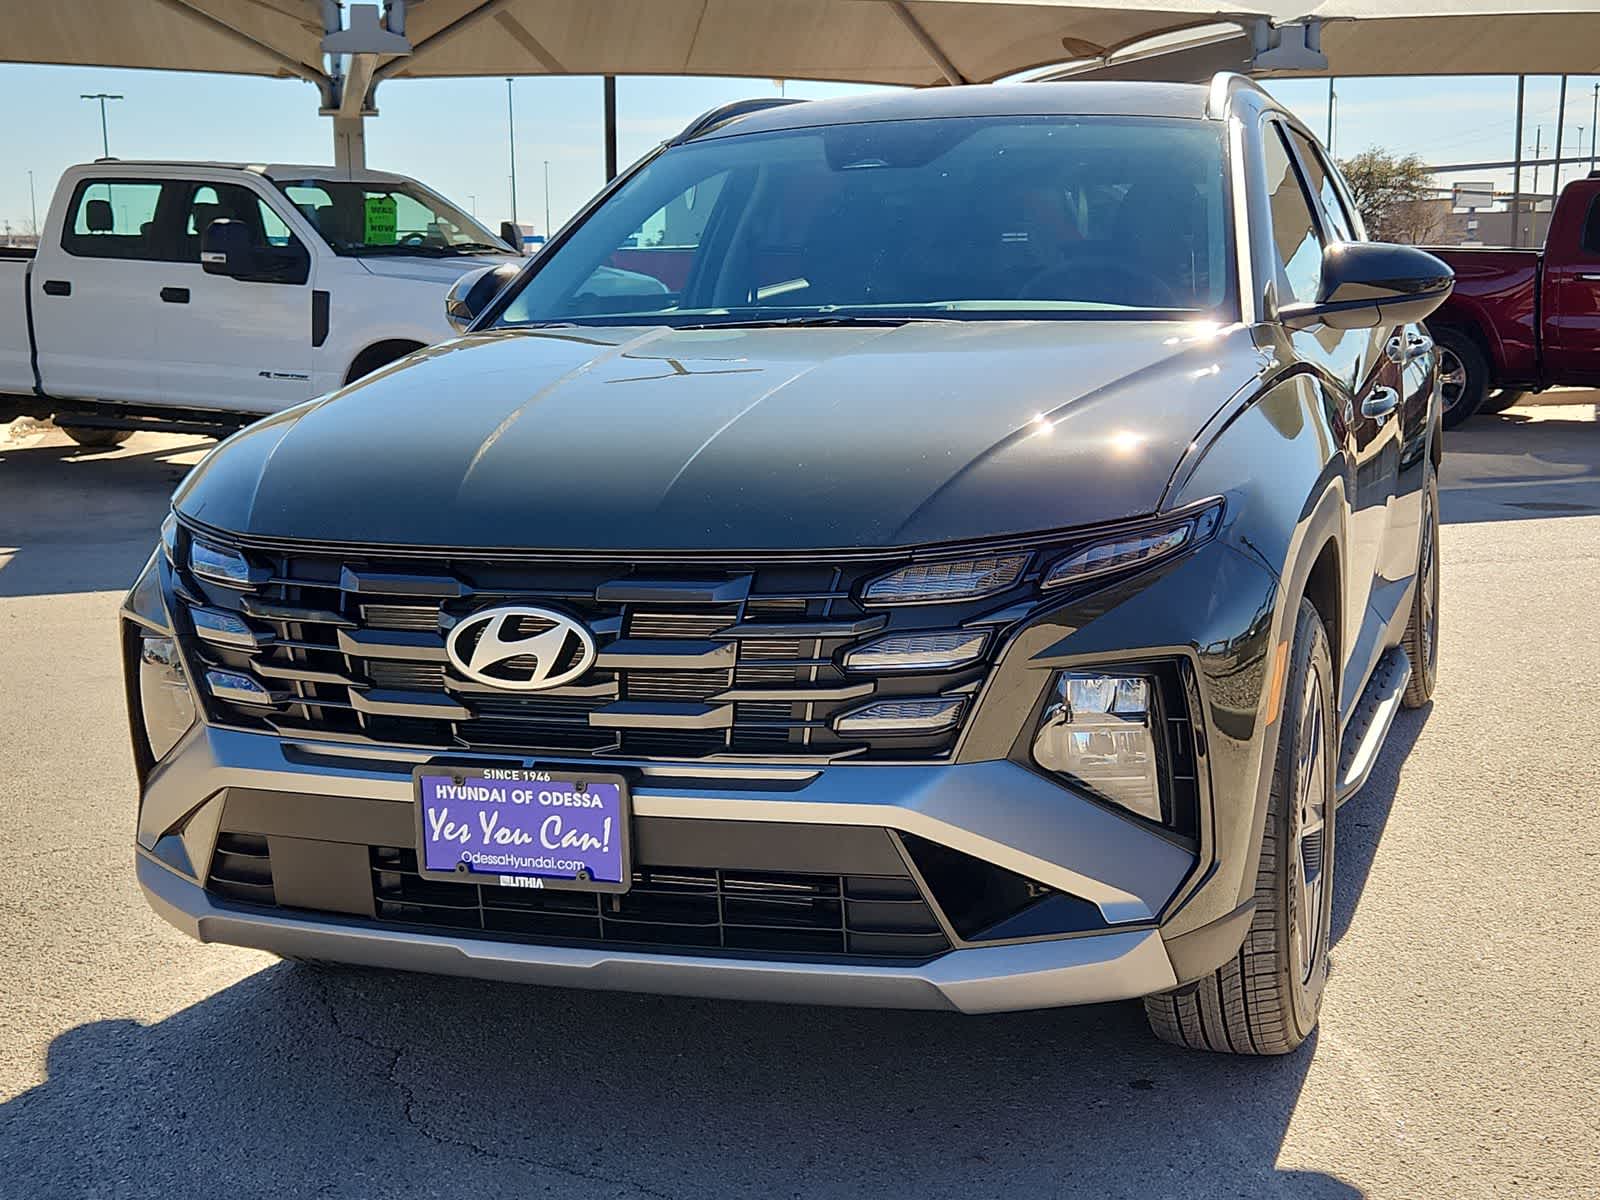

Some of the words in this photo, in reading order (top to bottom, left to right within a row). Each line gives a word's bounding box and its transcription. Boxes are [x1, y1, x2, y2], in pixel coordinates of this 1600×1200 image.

[370, 224, 394, 232] NOW
[483, 769, 520, 781] SINCE
[523, 771, 551, 782] 1946
[436, 785, 507, 803] HYUNDAI
[511, 789, 534, 805] OF
[538, 791, 604, 809] ODESSA
[428, 807, 471, 843] Yes
[479, 810, 533, 845] You
[540, 815, 612, 853] Can!
[461, 851, 585, 870] OdessaHyundai.com
[510, 876, 545, 889] LITHIA
